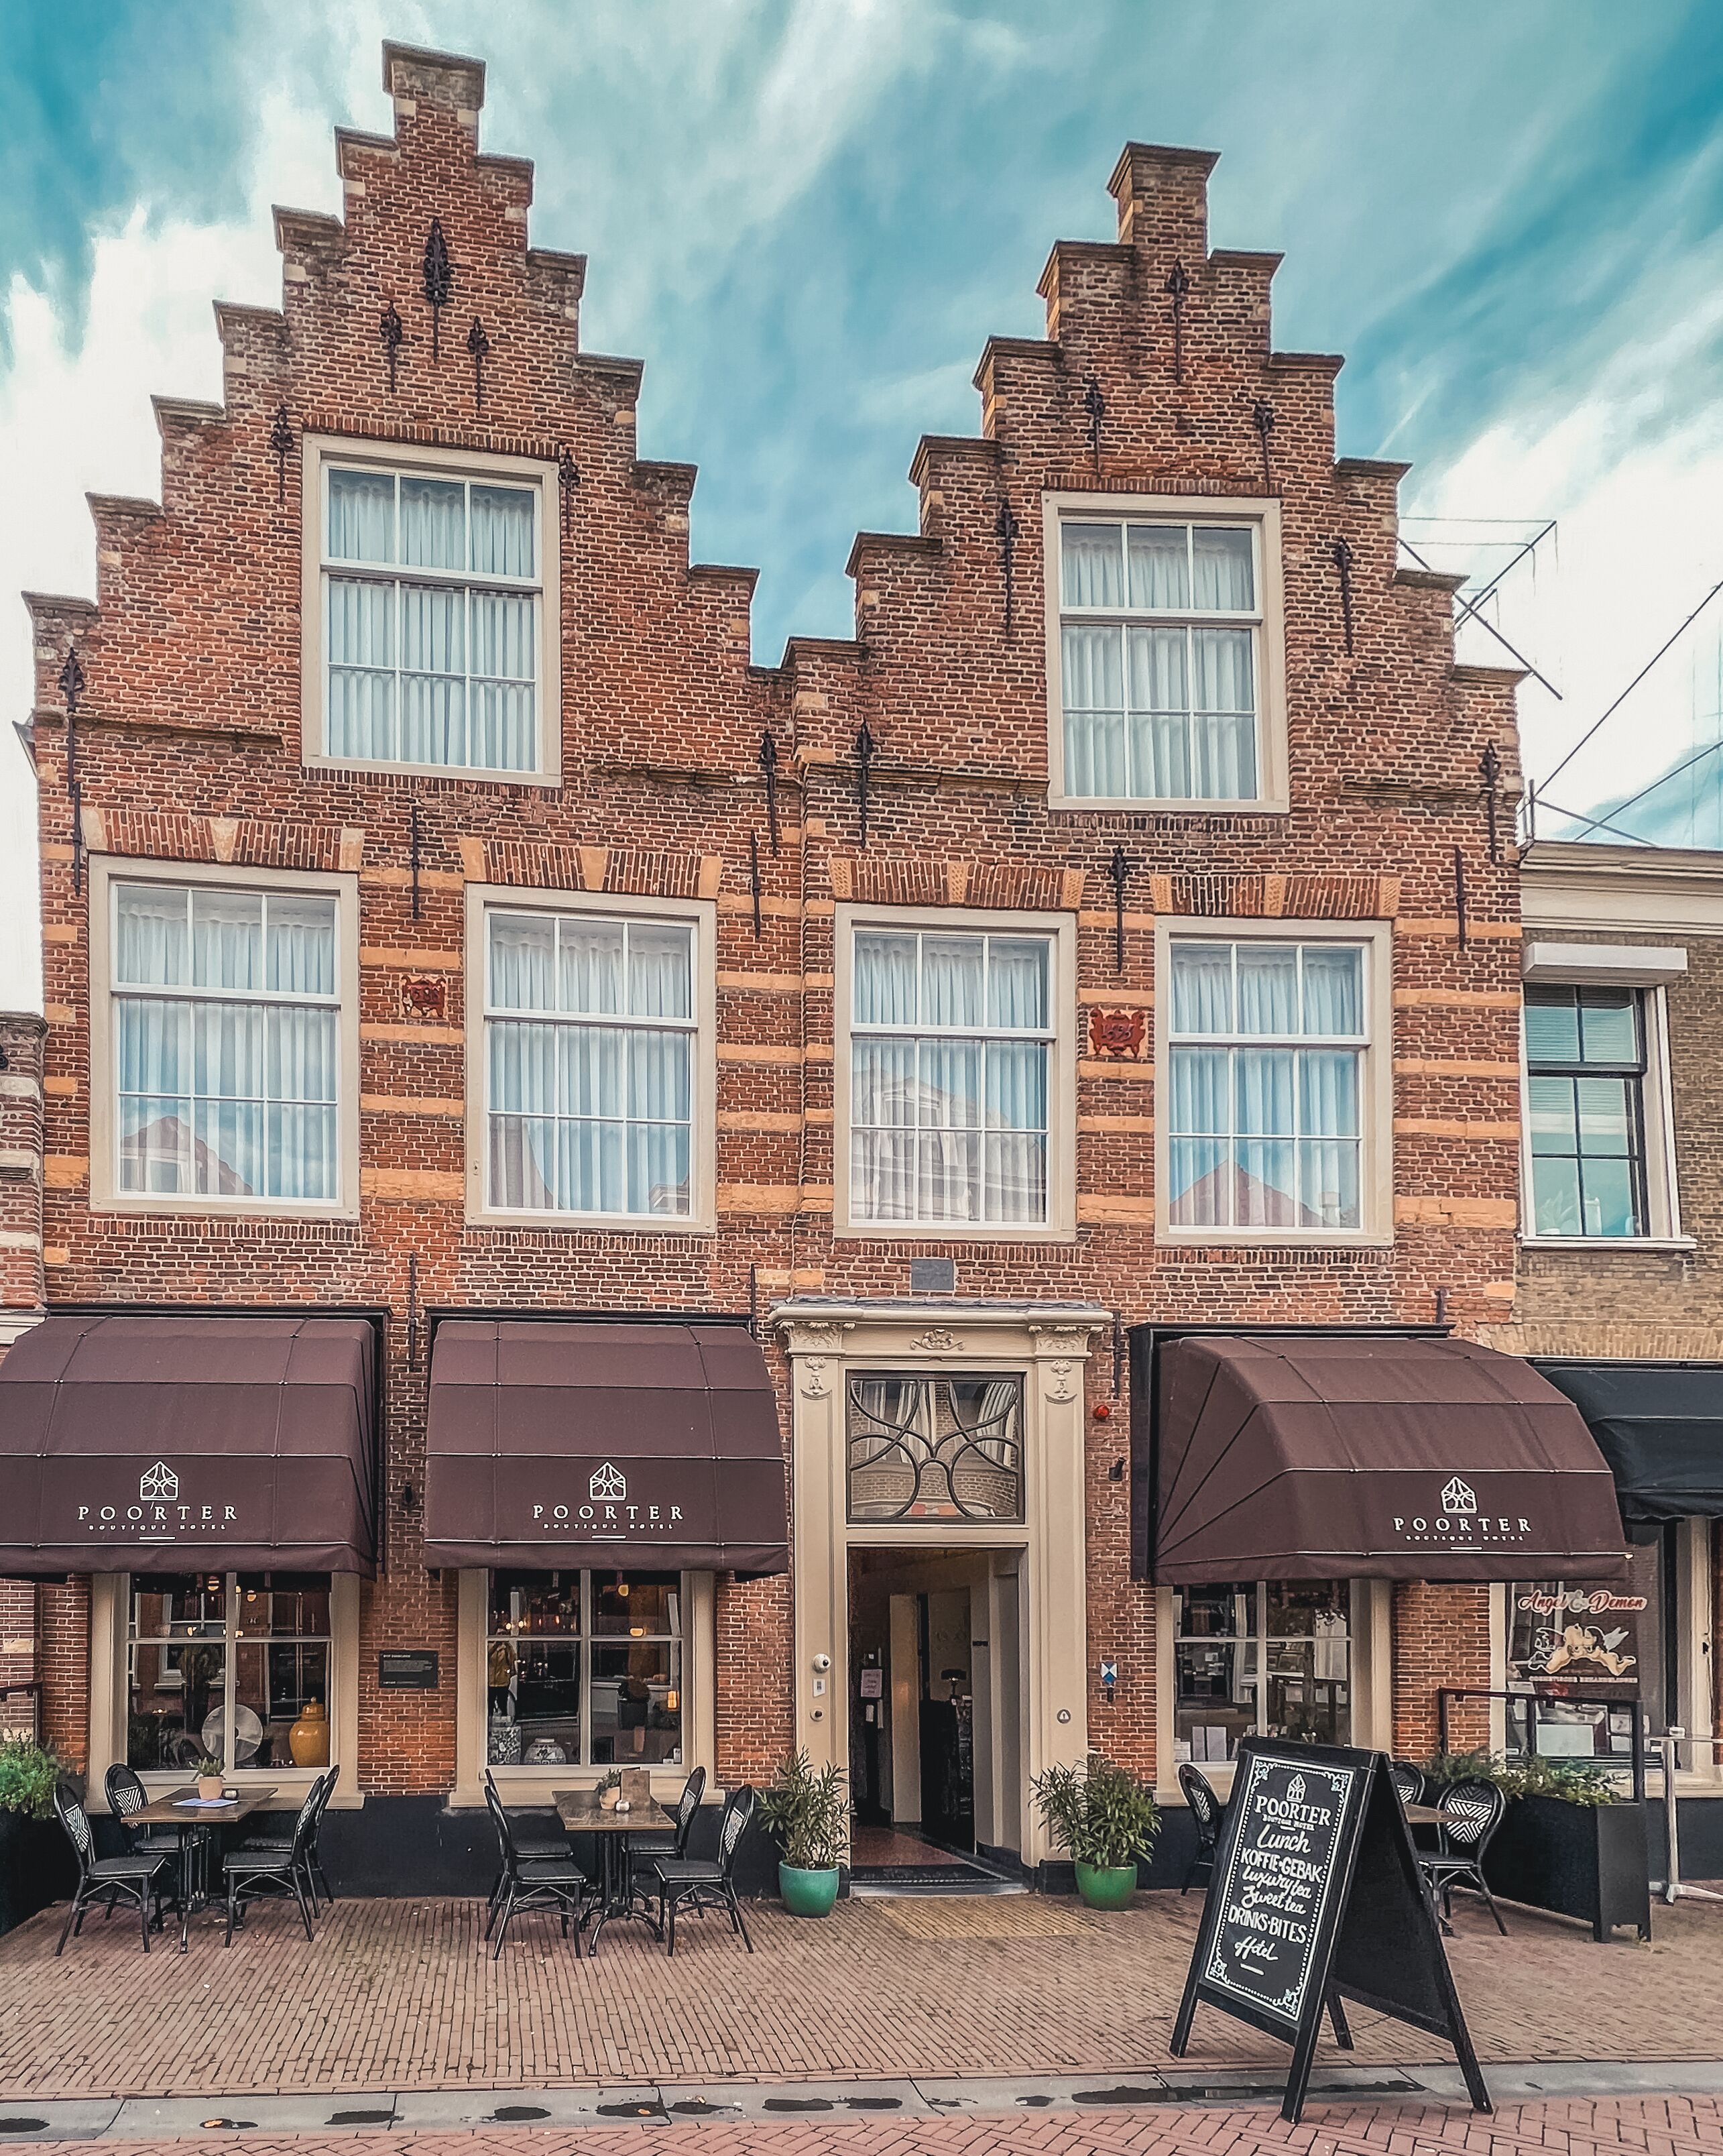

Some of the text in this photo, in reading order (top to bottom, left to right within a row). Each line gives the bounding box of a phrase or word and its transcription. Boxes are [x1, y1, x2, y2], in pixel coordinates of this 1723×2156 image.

[77, 1505, 237, 1520] POORTER
[532, 1504, 683, 1520] POORTER
[1392, 1517, 1532, 1532] POORTER
[1519, 1590, 1568, 1615] Angel
[1588, 1590, 1647, 1614] Demon
[1253, 1794, 1331, 1827] POORTER
[1256, 1823, 1311, 1854] Lunch
[1284, 1896, 1307, 1915] tea
[1234, 1935, 1279, 1962] Hotel
